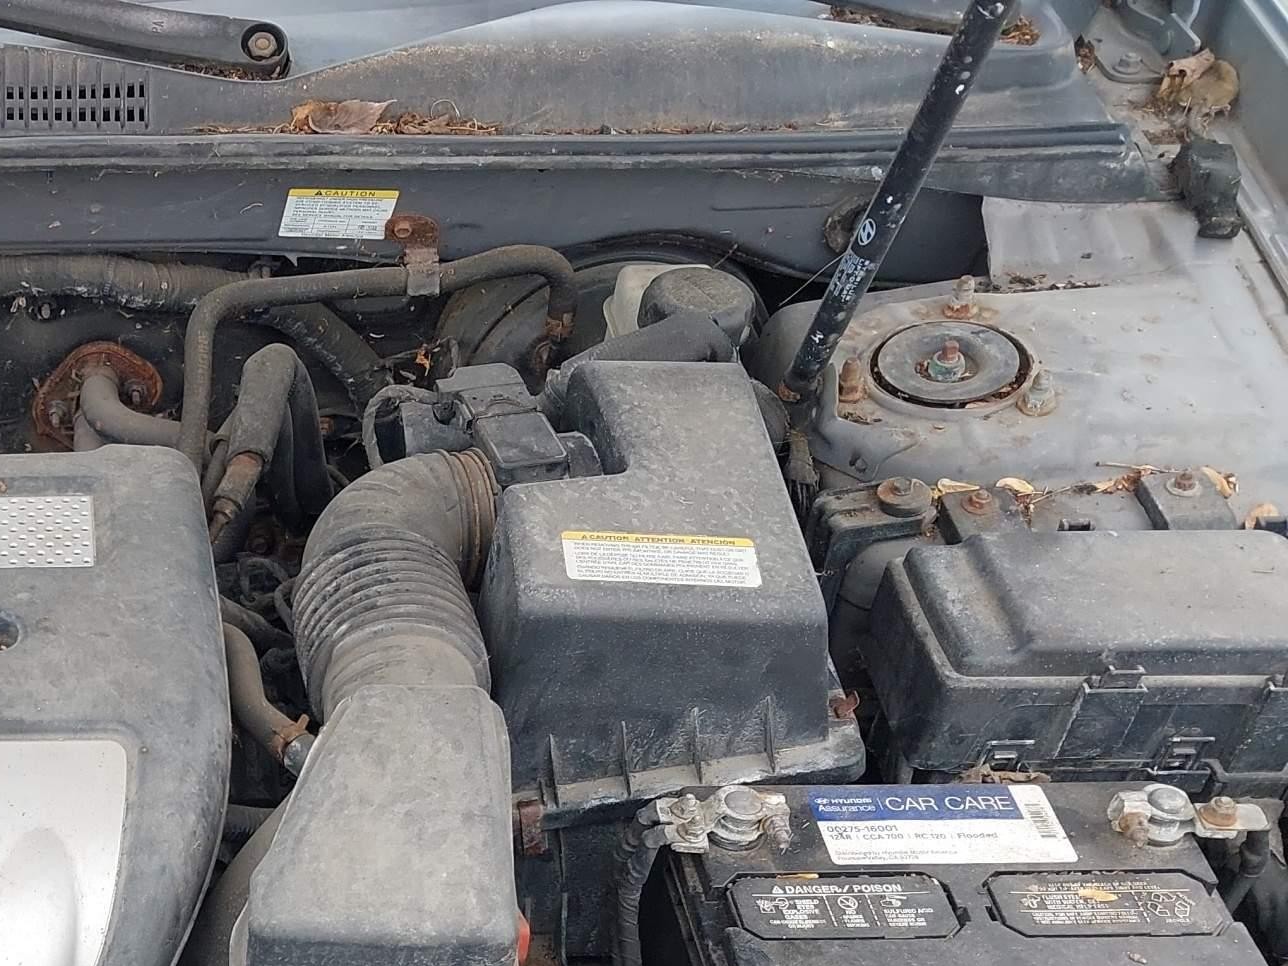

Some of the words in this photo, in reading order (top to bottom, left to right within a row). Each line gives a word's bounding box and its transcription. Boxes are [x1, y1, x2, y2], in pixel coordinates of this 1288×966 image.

[635, 536, 685, 544] ATTENTION
[885, 797, 939, 811] CAR
[944, 796, 1014, 811] CARE
[818, 804, 876, 813] Assurance
[852, 883, 903, 893] POISON
